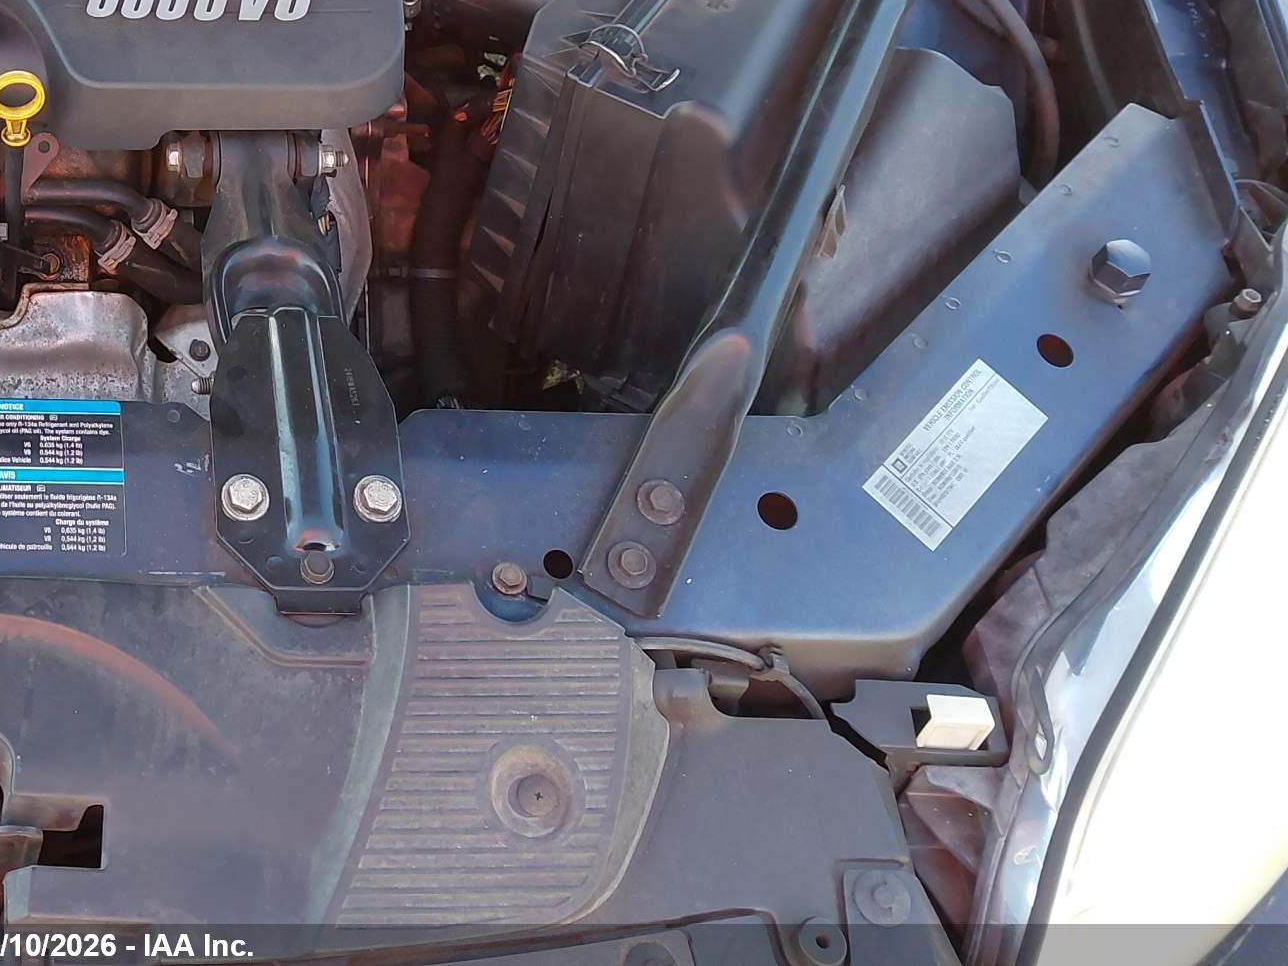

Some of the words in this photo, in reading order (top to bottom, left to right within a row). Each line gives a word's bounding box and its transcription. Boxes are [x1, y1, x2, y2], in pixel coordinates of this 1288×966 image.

[923, 410, 943, 432] VEHICLE
[940, 388, 964, 413] EMISSION
[960, 368, 982, 392] CONTROL
